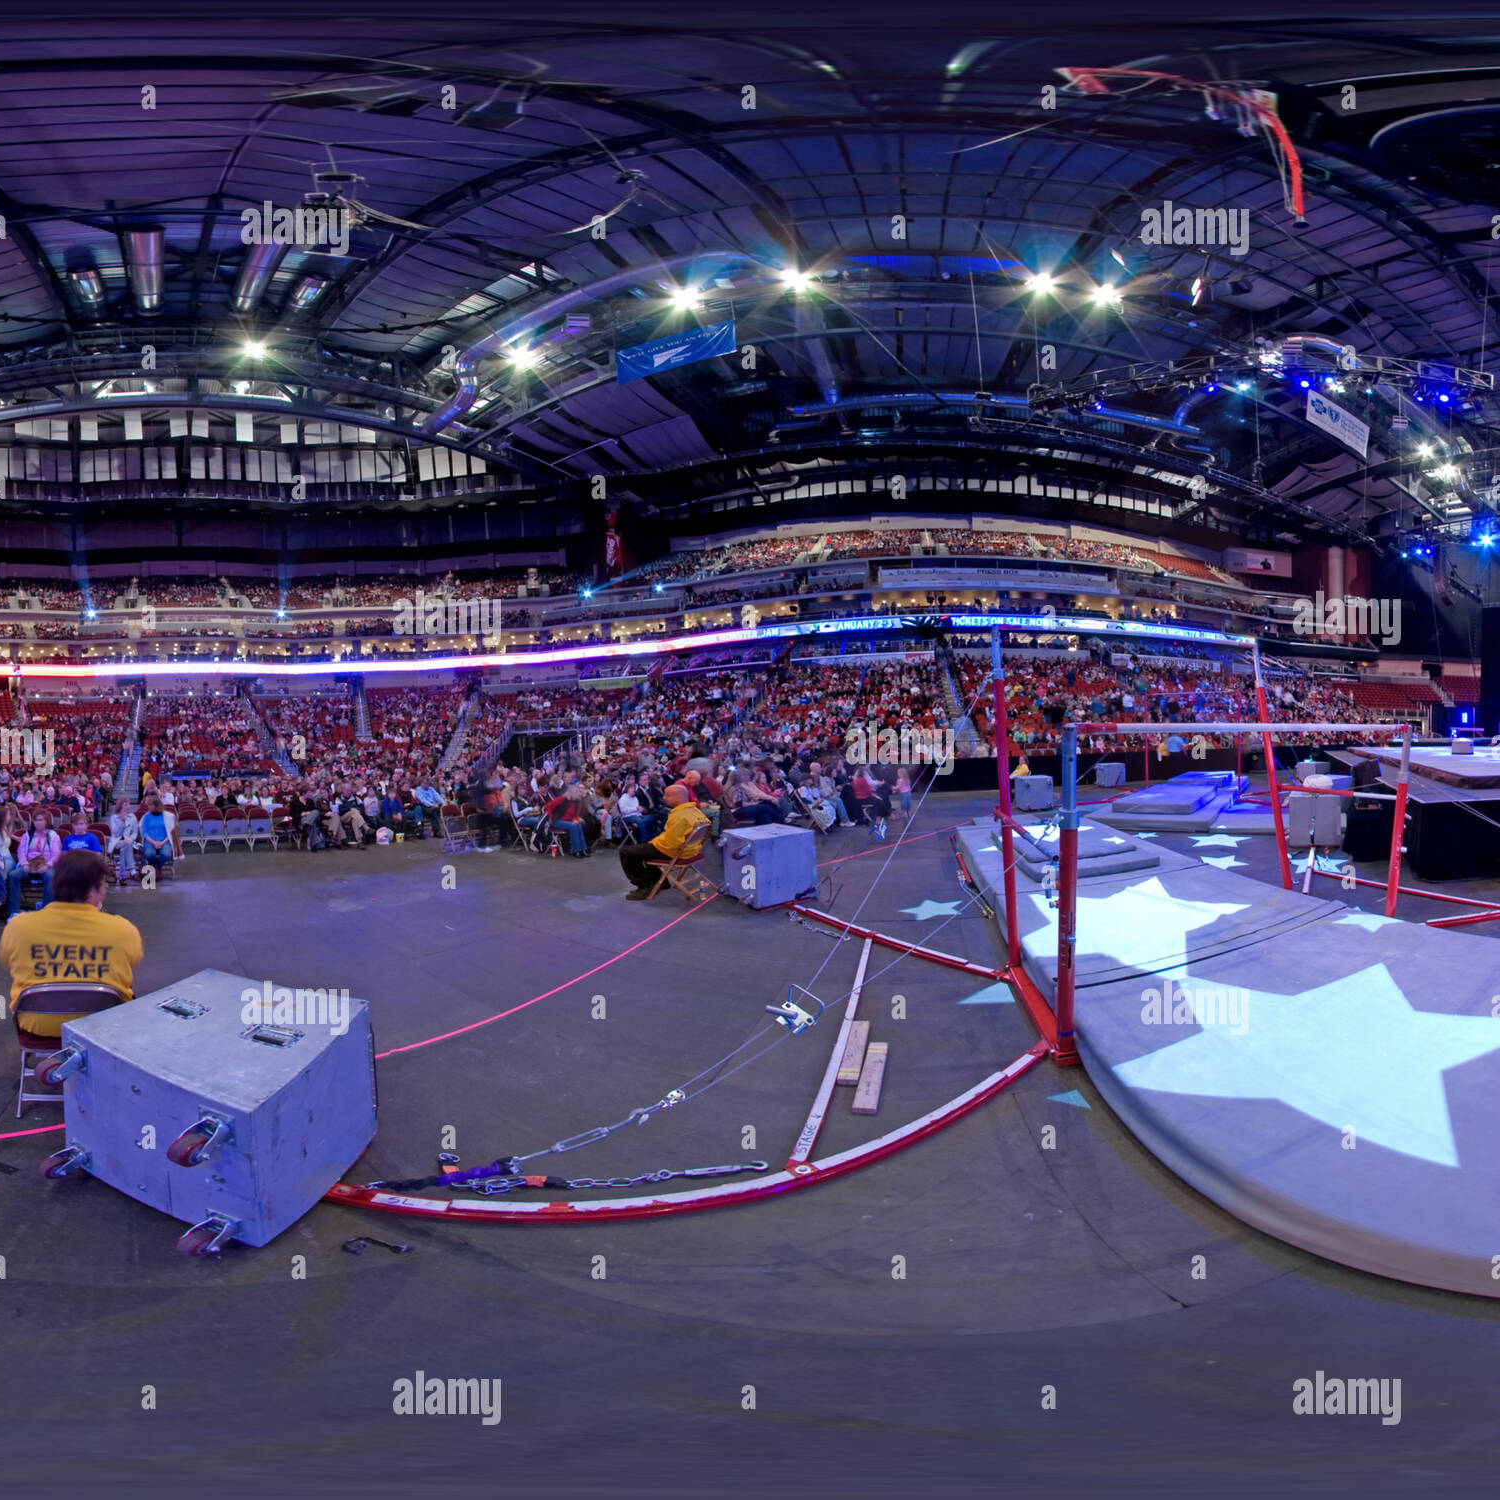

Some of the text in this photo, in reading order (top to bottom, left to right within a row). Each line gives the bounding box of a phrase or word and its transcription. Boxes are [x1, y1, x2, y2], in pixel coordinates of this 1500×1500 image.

[950, 616, 989, 626] TICKETS
[990, 616, 1004, 625] ON
[1005, 617, 1029, 626] SALE
[761, 627, 779, 638] JAM
[30, 944, 112, 961] EVENT
[34, 961, 111, 978] STAFF
[795, 1124, 817, 1154] STAGE
